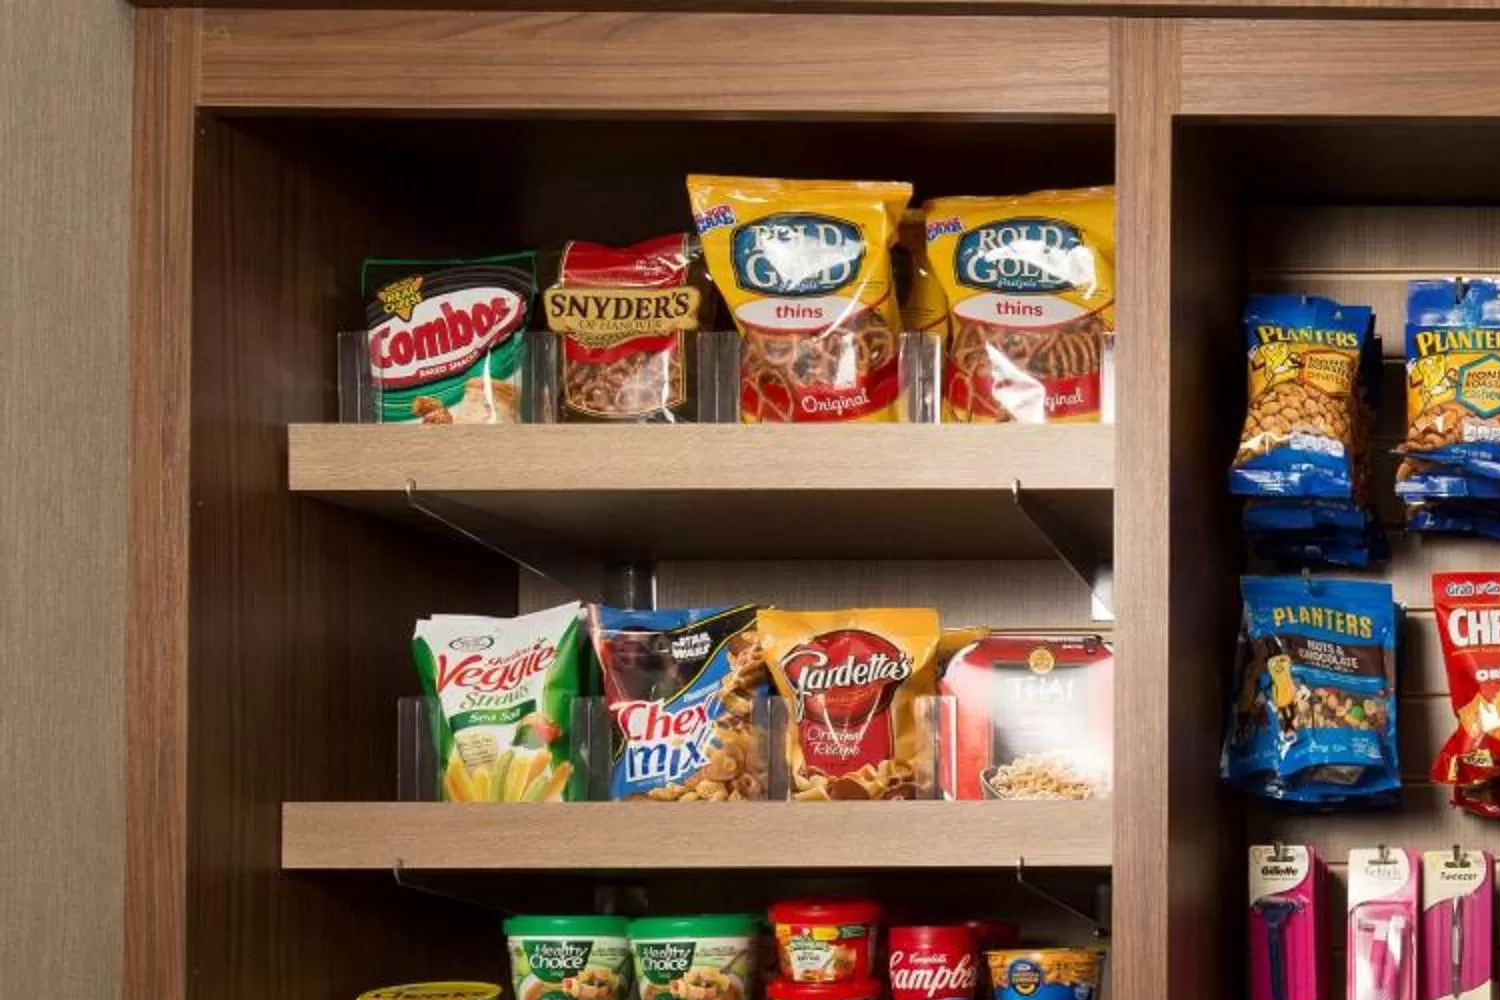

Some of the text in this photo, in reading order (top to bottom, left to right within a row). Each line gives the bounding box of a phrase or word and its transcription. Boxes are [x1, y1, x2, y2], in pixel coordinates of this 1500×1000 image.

[977, 226, 1065, 251] ROLD
[549, 291, 691, 321] SNYDER'S
[774, 304, 824, 319] thins
[995, 301, 1044, 317] thins
[370, 294, 511, 369] Combos
[1257, 323, 1359, 349] PLANTERS
[800, 389, 870, 414] Original
[1043, 388, 1083, 412] ginal
[1272, 605, 1374, 639] PLANTERS
[438, 640, 555, 694] Veggie
[779, 649, 913, 700] Gardetto's
[618, 694, 712, 743] Chex
[625, 731, 711, 782] mix
[1260, 865, 1299, 878] Gillette
[1439, 870, 1479, 882] Tweezer
[529, 952, 584, 971] Choice
[534, 941, 589, 960] Healthy
[640, 953, 689, 972] Choice
[642, 942, 695, 962] Healthy
